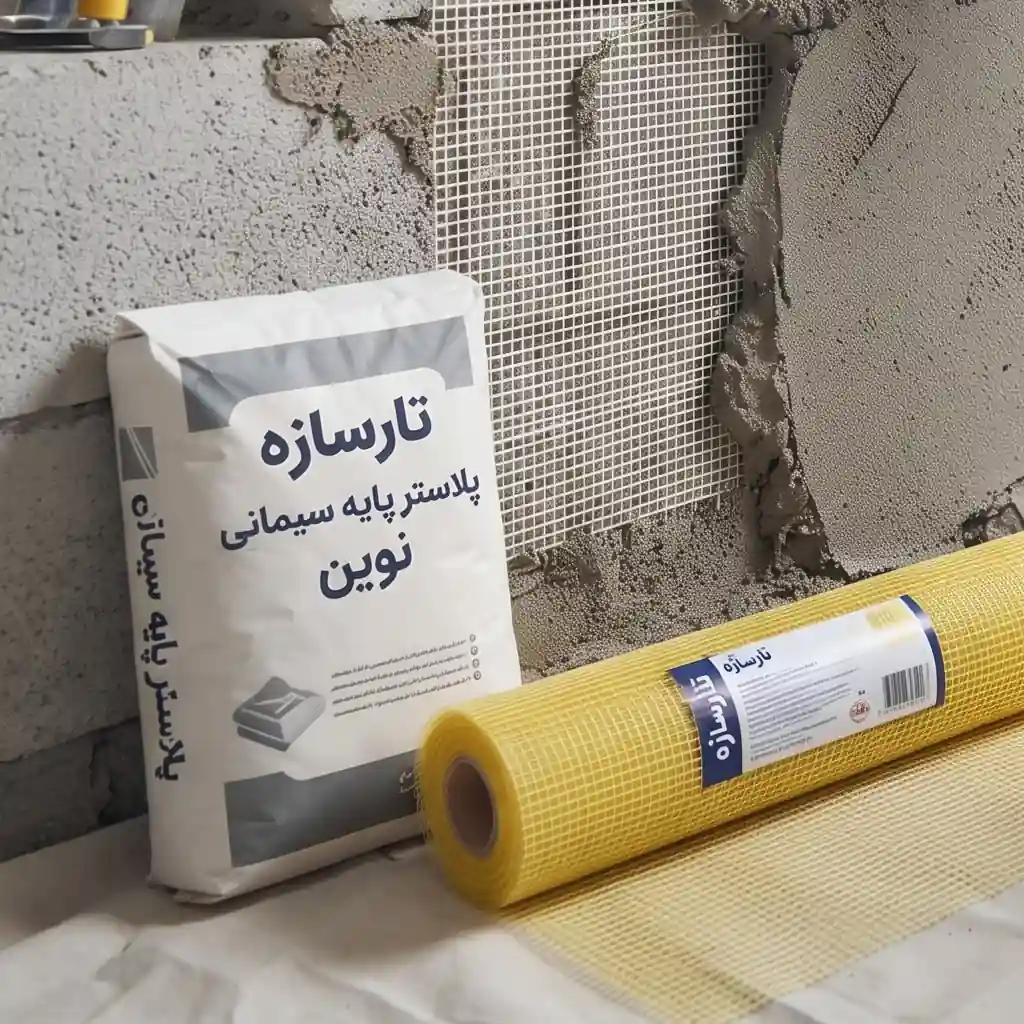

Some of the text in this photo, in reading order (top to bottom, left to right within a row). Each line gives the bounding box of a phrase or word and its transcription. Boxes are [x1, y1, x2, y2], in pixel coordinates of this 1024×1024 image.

[261, 396, 432, 481] تارسازه
[220, 468, 480, 551] پلاستر پایه سیمانی
[319, 531, 413, 600] نوین
